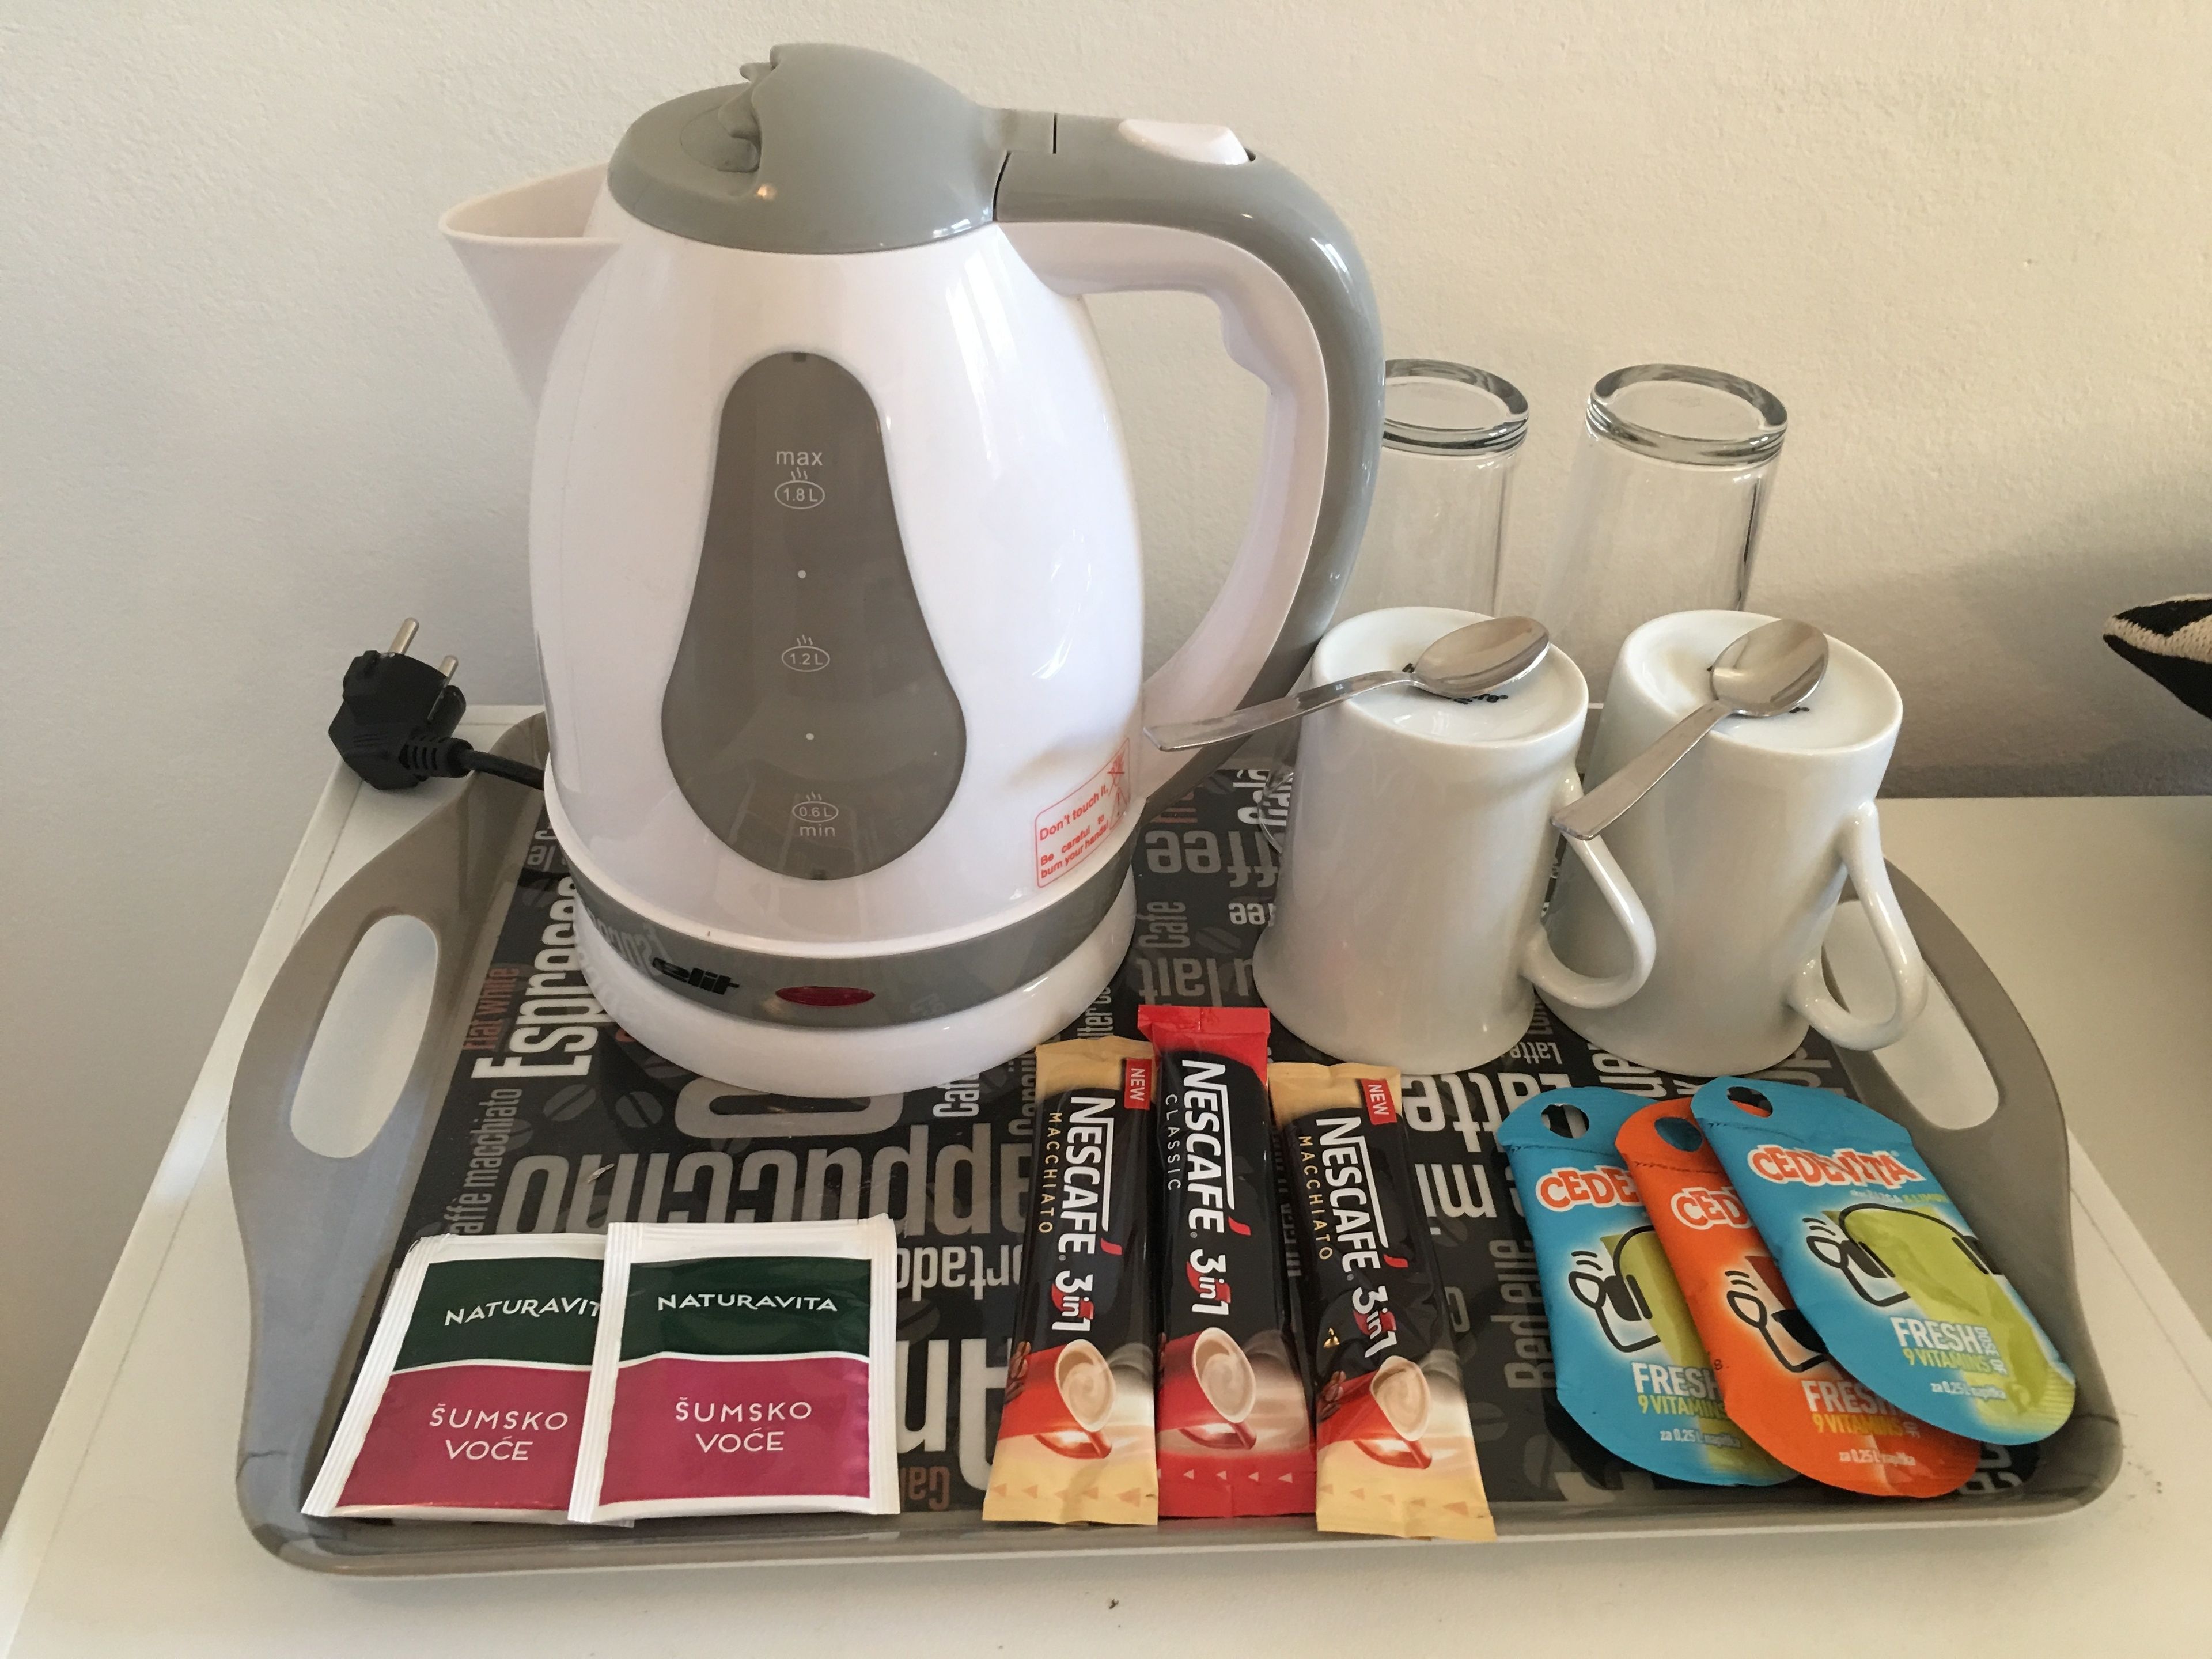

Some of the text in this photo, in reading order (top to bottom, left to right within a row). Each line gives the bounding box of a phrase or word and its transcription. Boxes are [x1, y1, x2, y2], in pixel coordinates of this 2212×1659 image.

[776, 450, 823, 466] max
[800, 824, 836, 837] min
[1039, 815, 1070, 841] Don't
[1072, 793, 1099, 820] touch
[1040, 814, 1105, 866] Be careful to
[1041, 860, 1063, 878] burn
[1065, 846, 1083, 866] your
[1130, 1066, 1146, 1102] NEW
[1368, 1083, 1389, 1116] NEW
[462, 1088, 522, 1187] macchiato
[1165, 1093, 1181, 1191] CLASSIC
[1039, 1112, 1063, 1233] MACCHIATO
[1752, 1146, 1918, 1185] CEDEVITA
[1298, 1135, 1333, 1260] MACCHIATO
[657, 1294, 838, 1313] NATURAVITA
[1890, 1317, 1983, 1354] FRESH
[1914, 1348, 1992, 1373] VITAMINS
[429, 1403, 568, 1431] ŠUMSKO
[675, 1396, 812, 1422] ŠUMSKO
[1637, 1394, 1649, 1415] 9
[445, 1435, 534, 1461] VOĆE
[695, 1427, 785, 1453] VOĆE
